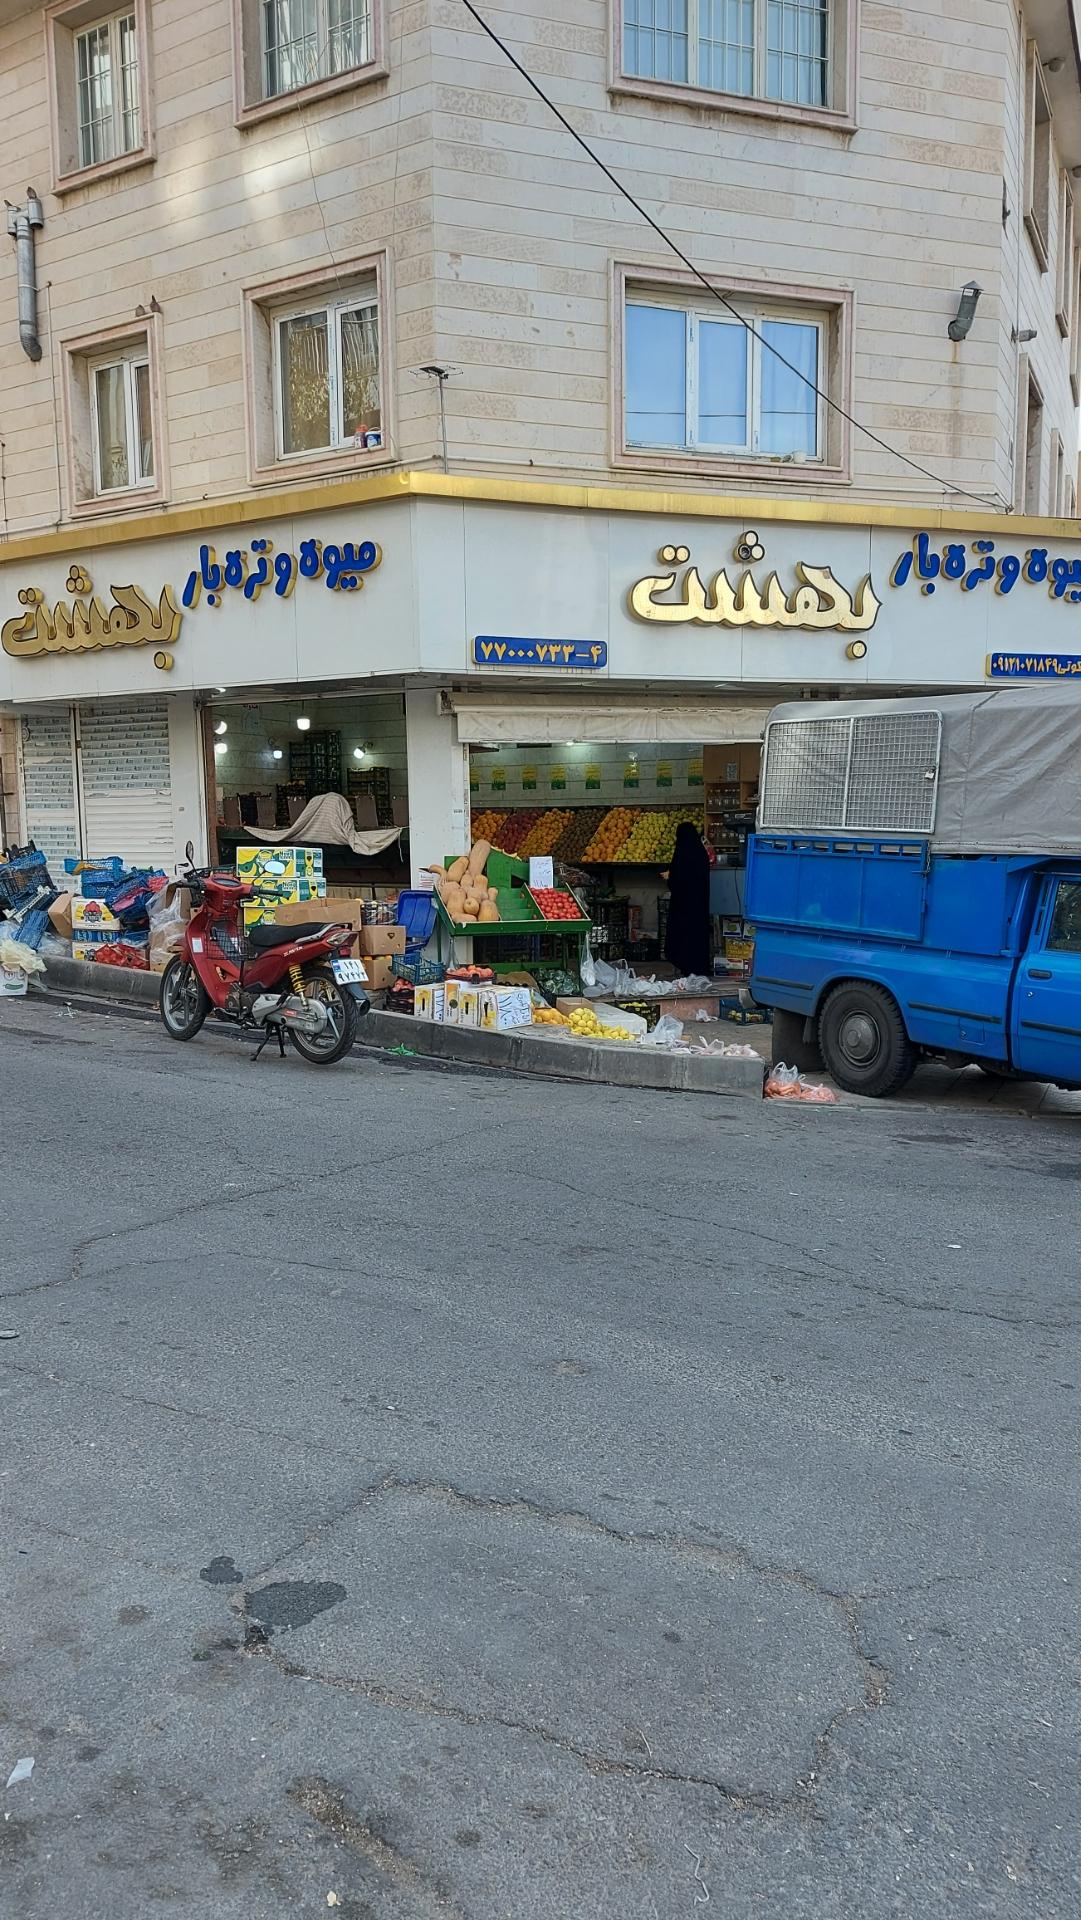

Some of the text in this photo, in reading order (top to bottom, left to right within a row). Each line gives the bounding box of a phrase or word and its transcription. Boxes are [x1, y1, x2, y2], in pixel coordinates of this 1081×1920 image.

[299, 538, 382, 592] میوه
[630, 530, 882, 661] بهشت
[1022, 548, 1081, 603] یوه
[1, 564, 182, 671] بهشت
